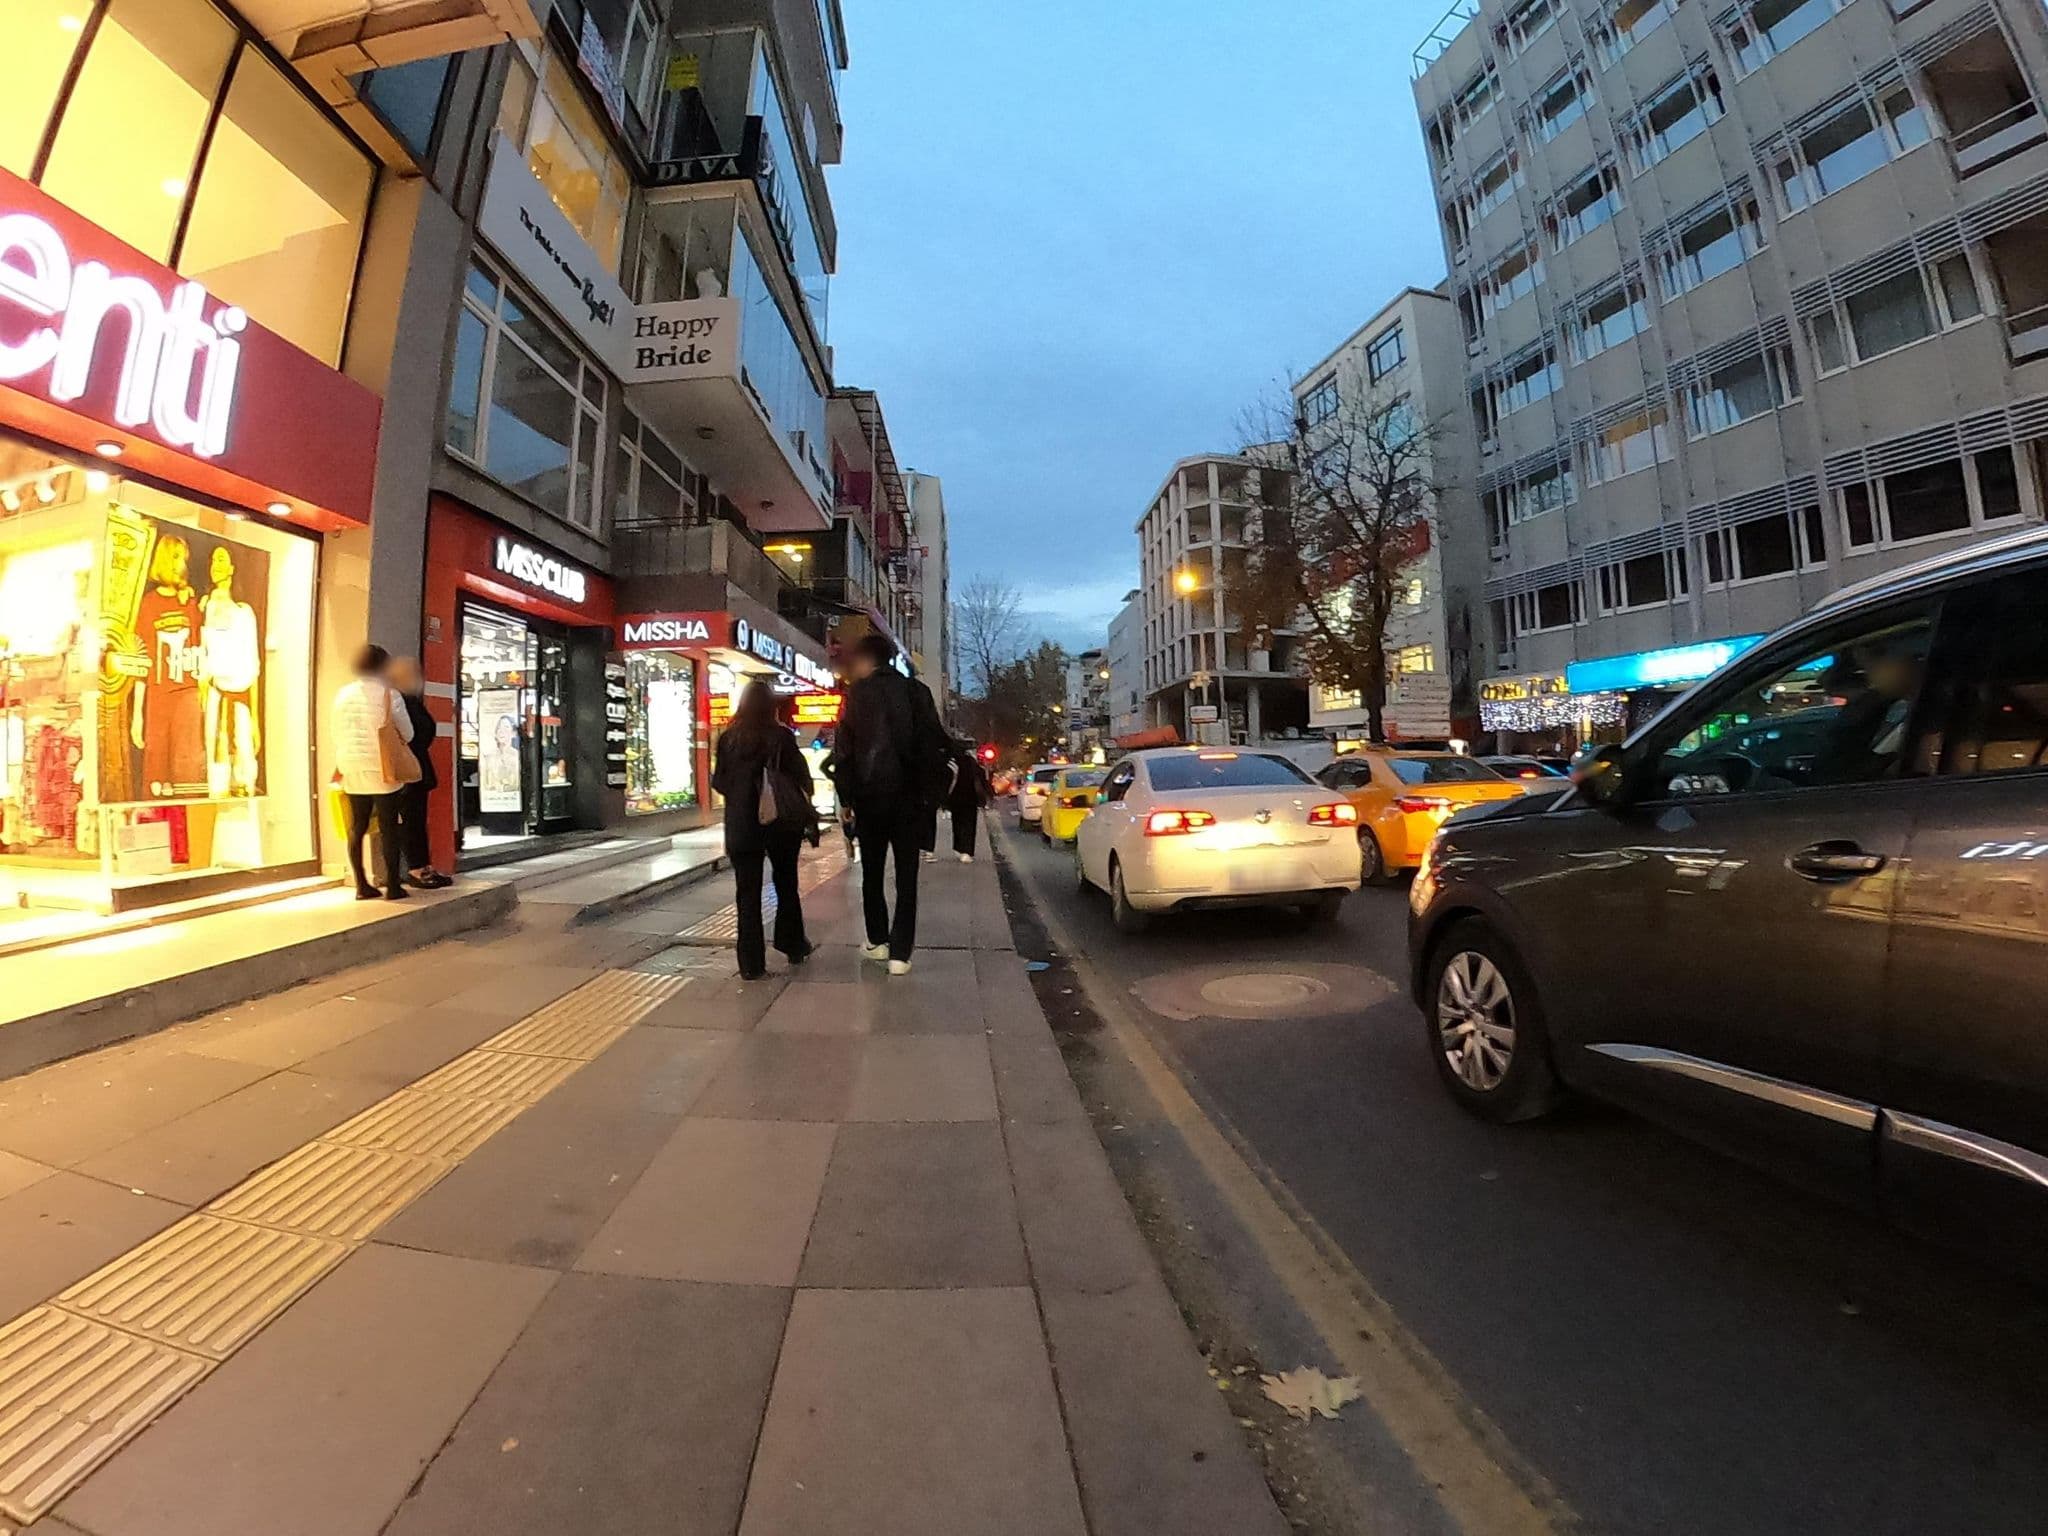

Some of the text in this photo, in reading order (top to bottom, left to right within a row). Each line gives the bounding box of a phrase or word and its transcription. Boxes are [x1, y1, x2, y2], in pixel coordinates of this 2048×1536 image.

[657, 158, 739, 180] DIVA
[634, 315, 720, 340] Happy
[635, 343, 712, 369] Bride
[624, 620, 709, 642] MISSHA
